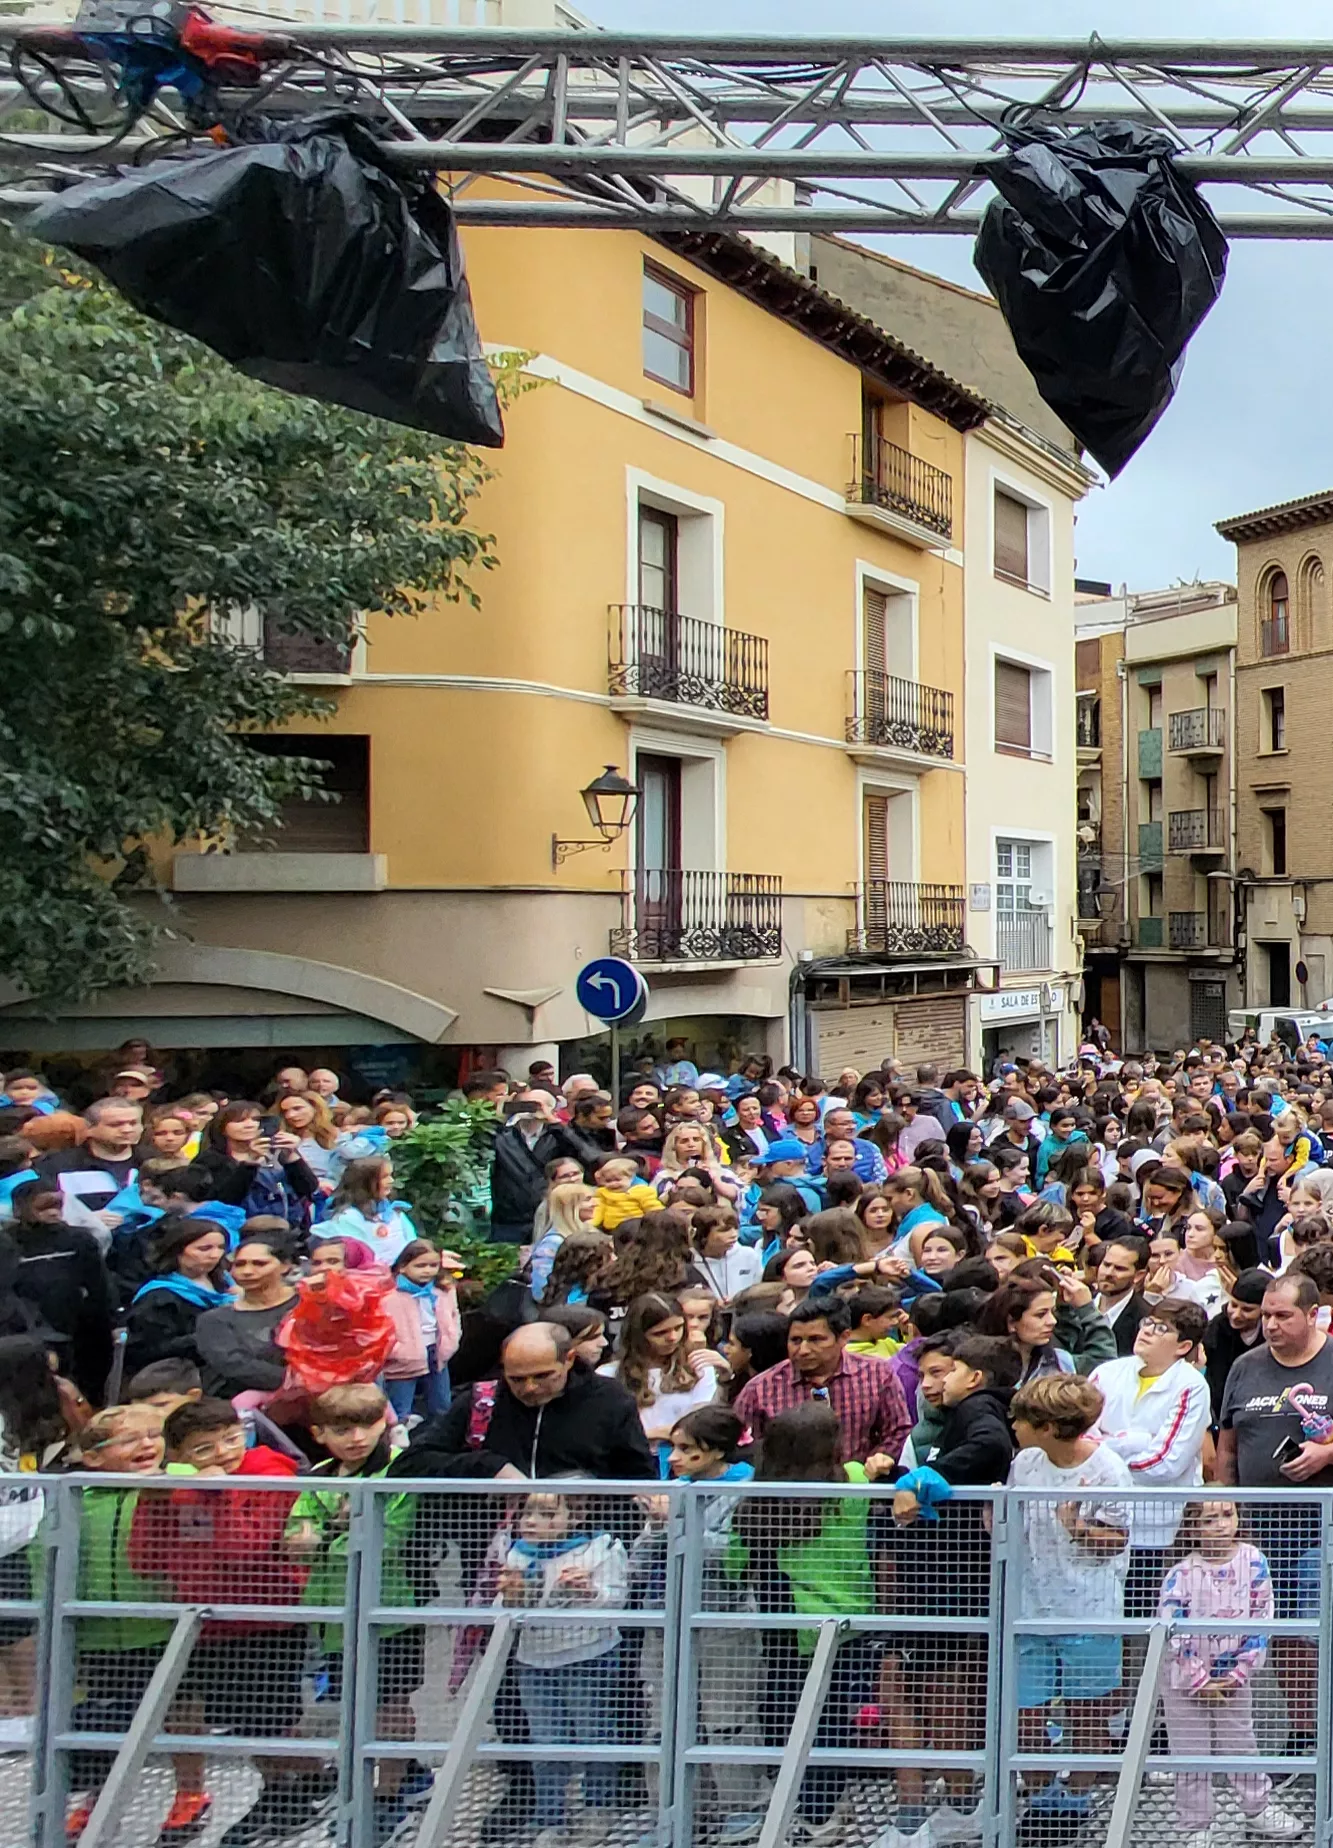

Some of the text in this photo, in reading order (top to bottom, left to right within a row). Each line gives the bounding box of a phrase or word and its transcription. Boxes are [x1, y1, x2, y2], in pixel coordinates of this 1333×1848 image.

[1001, 995, 1019, 1009] SALA
[1020, 994, 1030, 1007] DE
[1245, 1395, 1279, 1408] JACK
[1290, 1393, 1329, 1406] ONES
